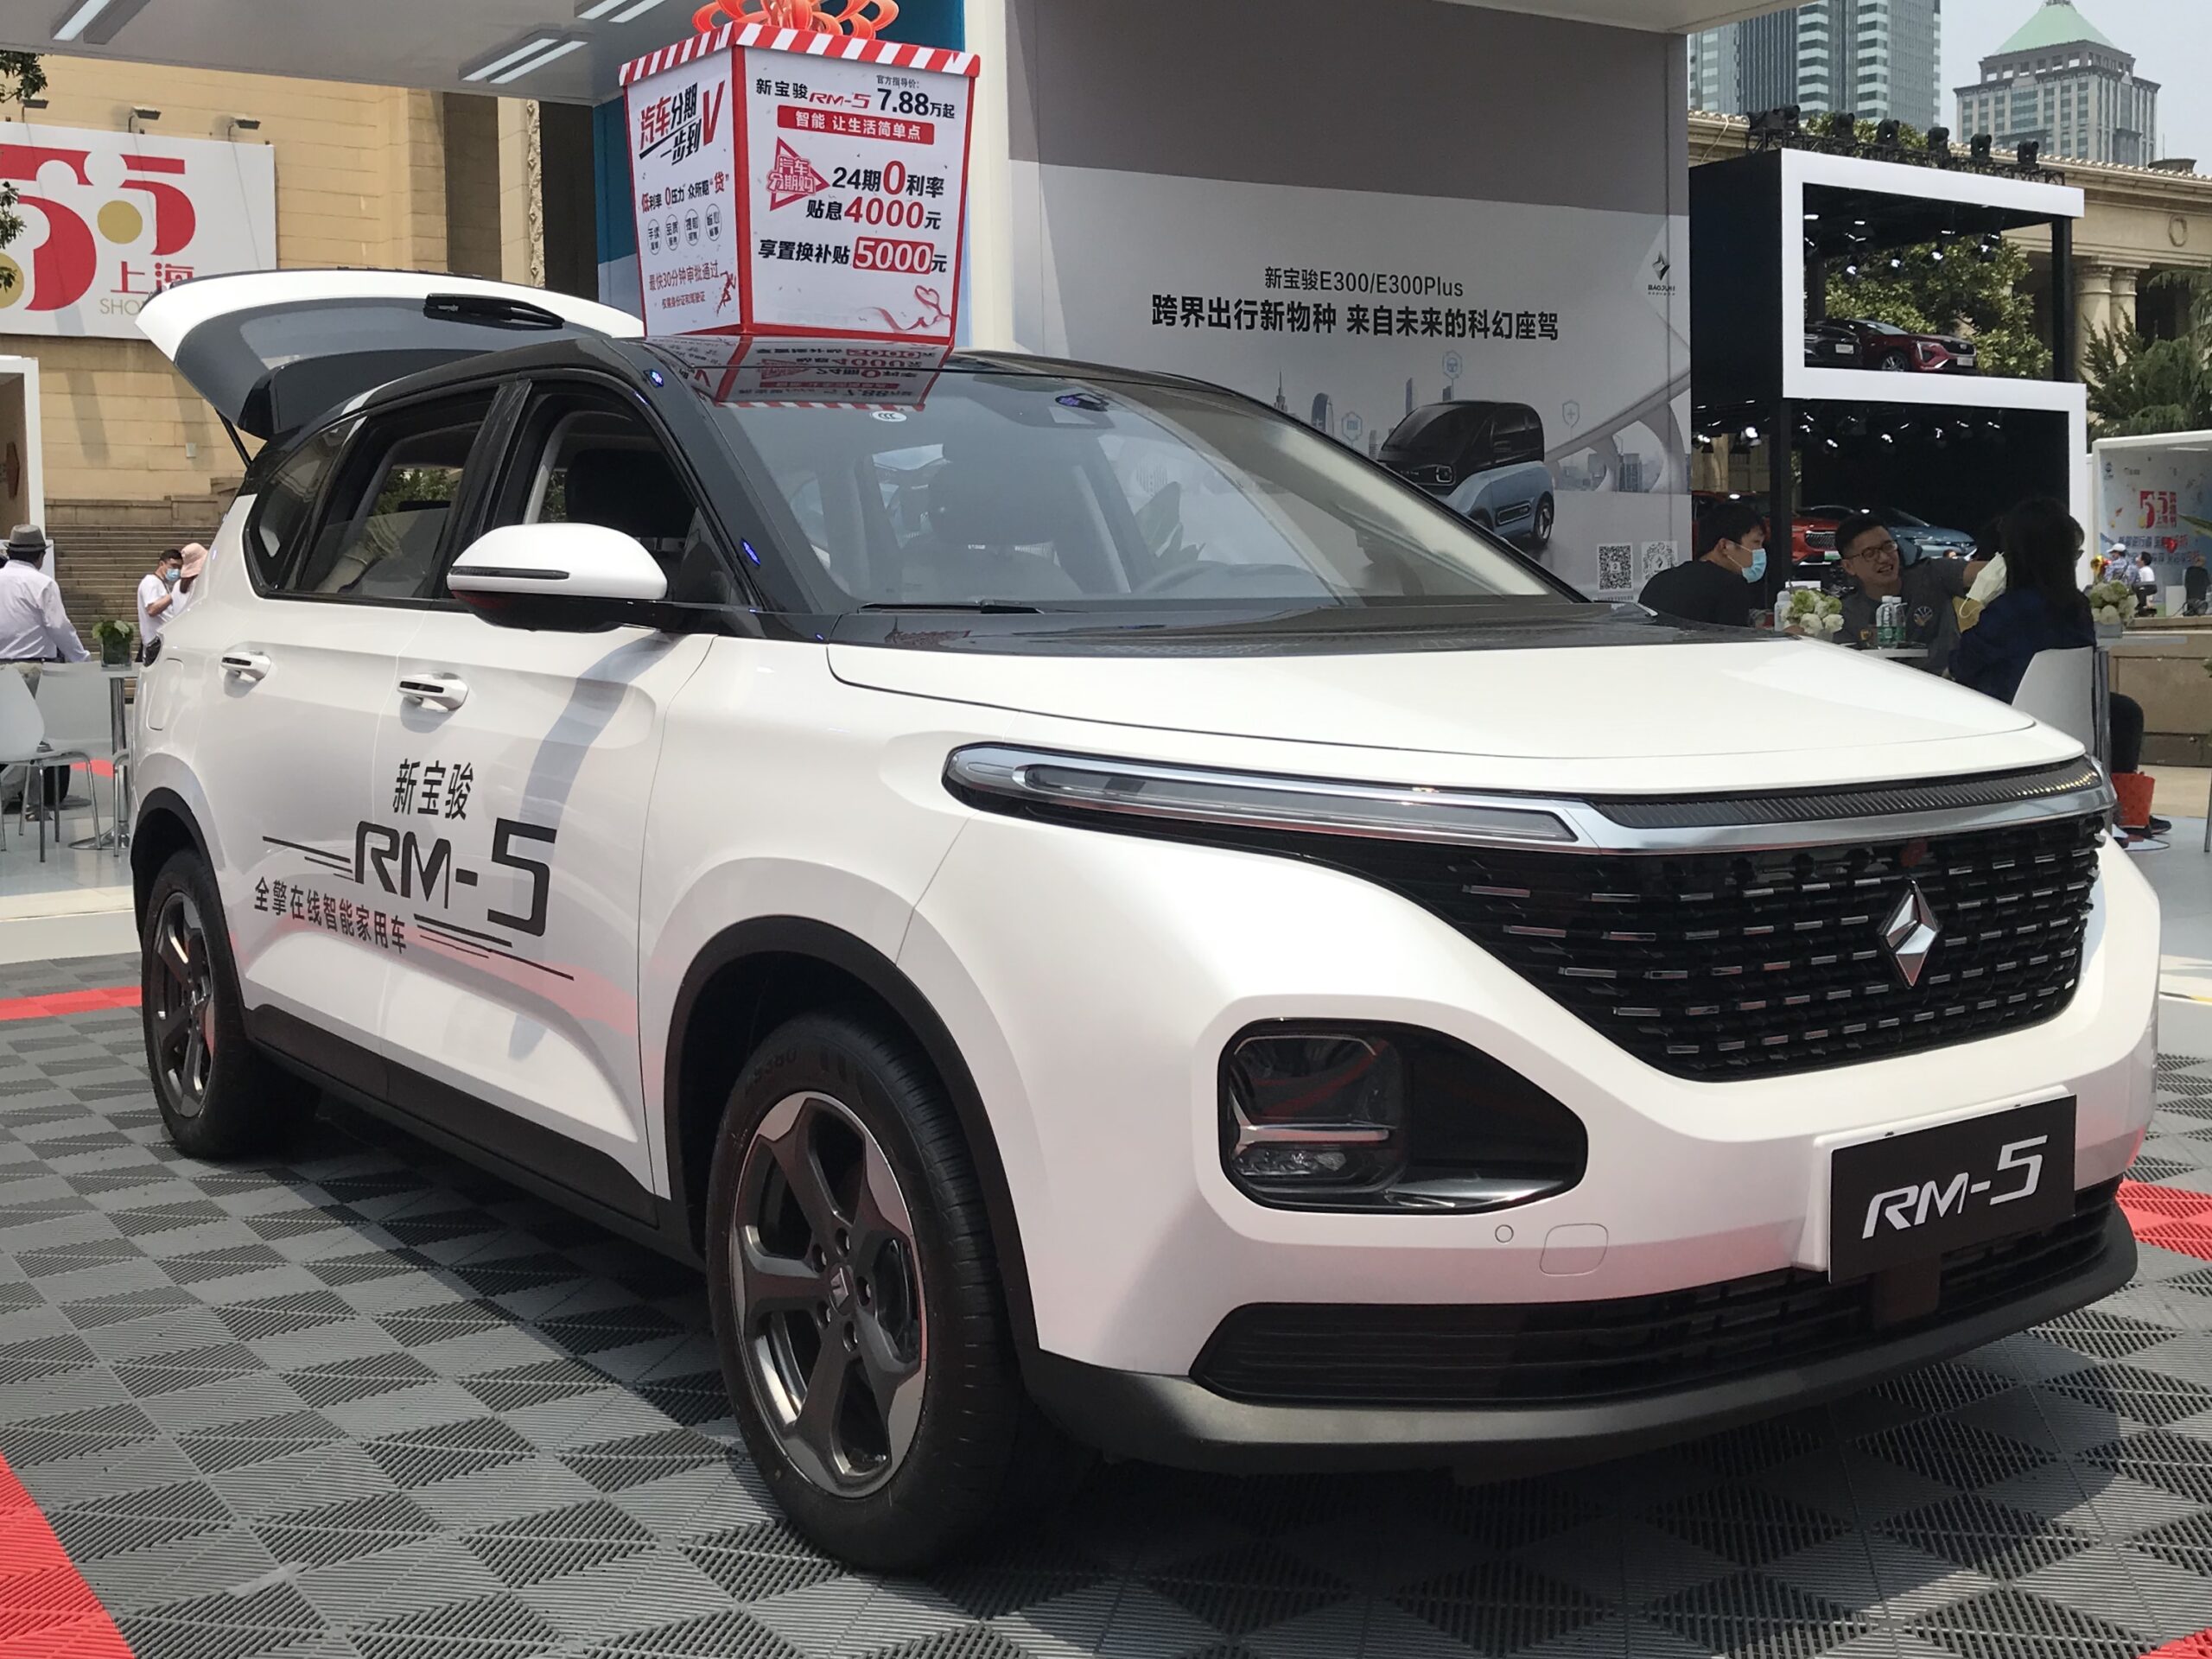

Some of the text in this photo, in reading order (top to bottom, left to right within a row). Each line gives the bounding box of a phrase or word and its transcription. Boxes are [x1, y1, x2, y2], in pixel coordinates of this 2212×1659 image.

[795, 111, 921, 141] 智能 让生活简单点
[768, 173, 816, 194] 分期购
[779, 157, 810, 176] 汽车
[805, 196, 942, 231] 贴息4000元
[758, 239, 948, 274] 享置换补贴5000元
[1152, 294, 1559, 340] 跨界出行新物种 来自未来的科幻座驾
[392, 758, 474, 821] 新宝骏
[355, 817, 558, 938] RM-5
[254, 876, 407, 955] 全擎在线智能家用车
[1861, 1135, 2049, 1240] RM-5
